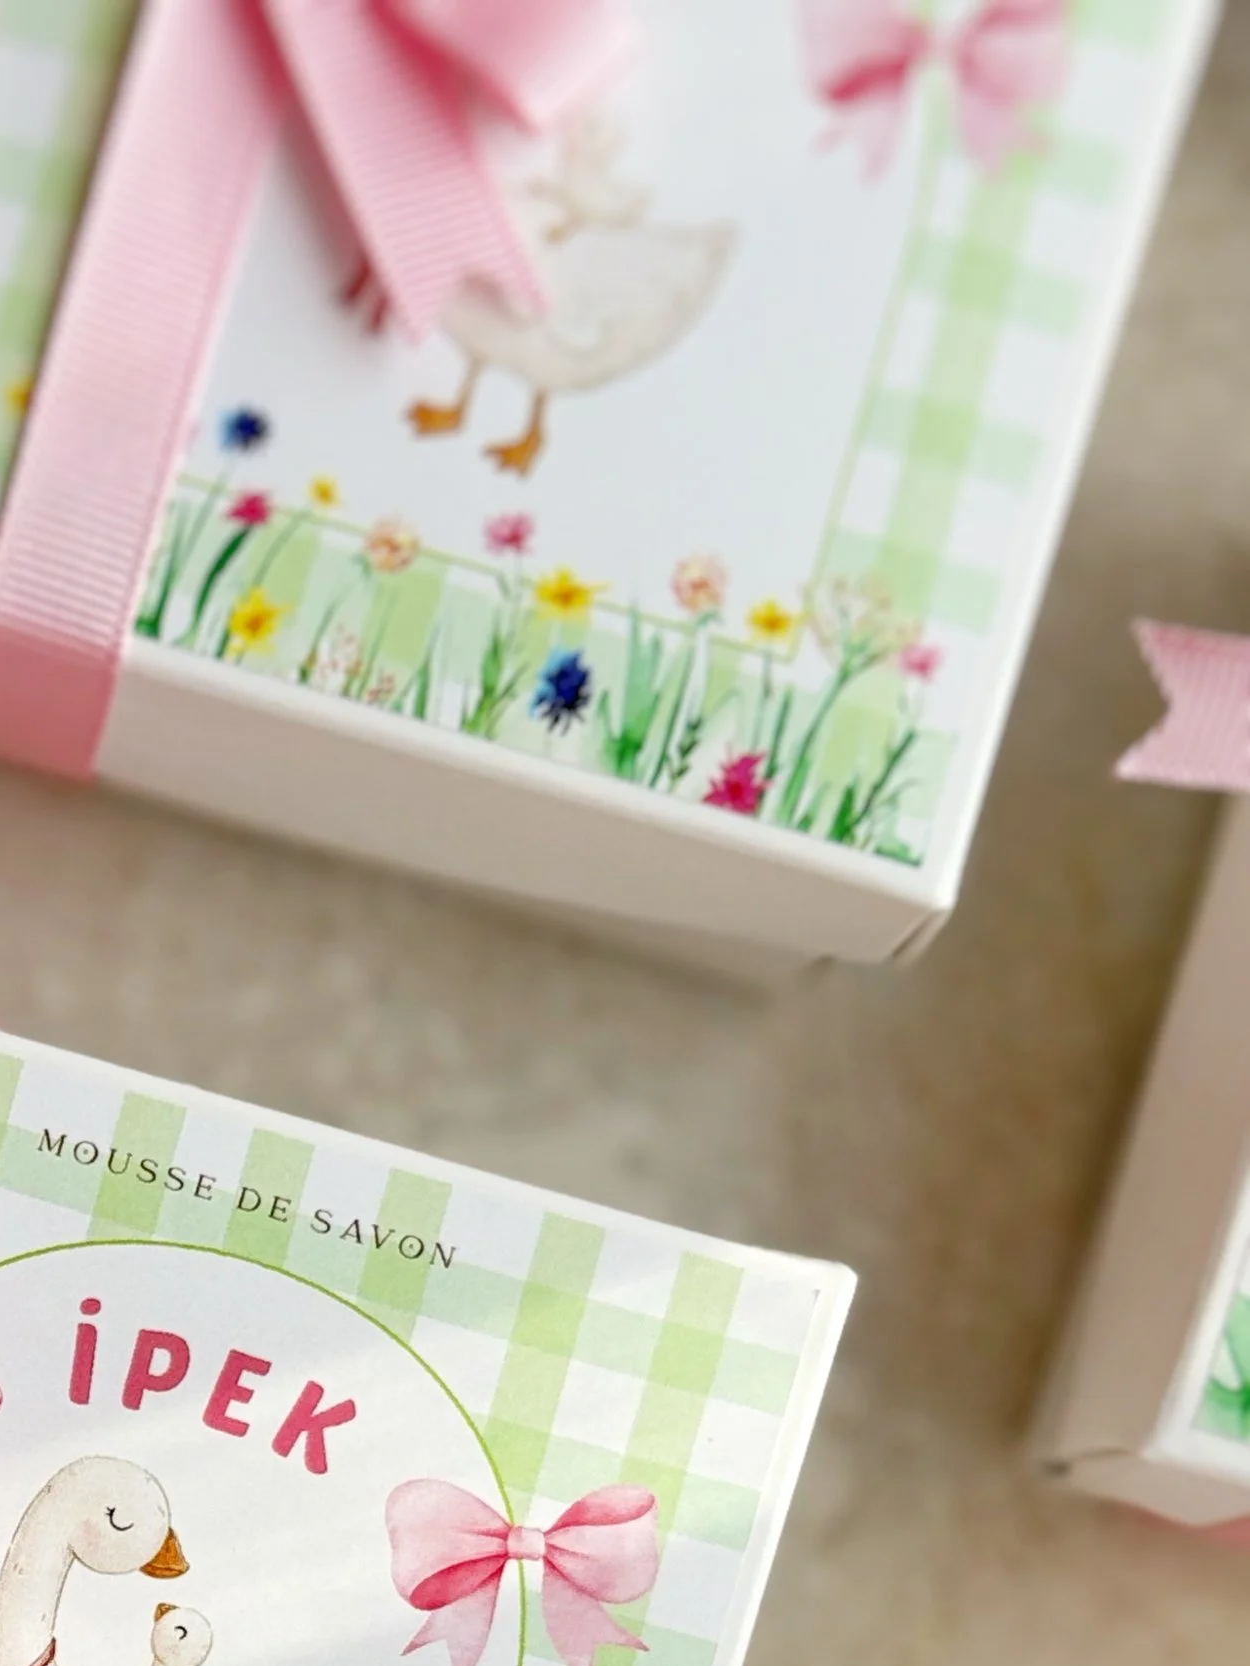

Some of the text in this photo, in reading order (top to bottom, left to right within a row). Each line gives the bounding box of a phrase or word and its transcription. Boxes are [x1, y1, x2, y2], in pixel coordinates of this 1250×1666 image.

[38, 1128, 457, 1269] MOUSSE DE SAVON
